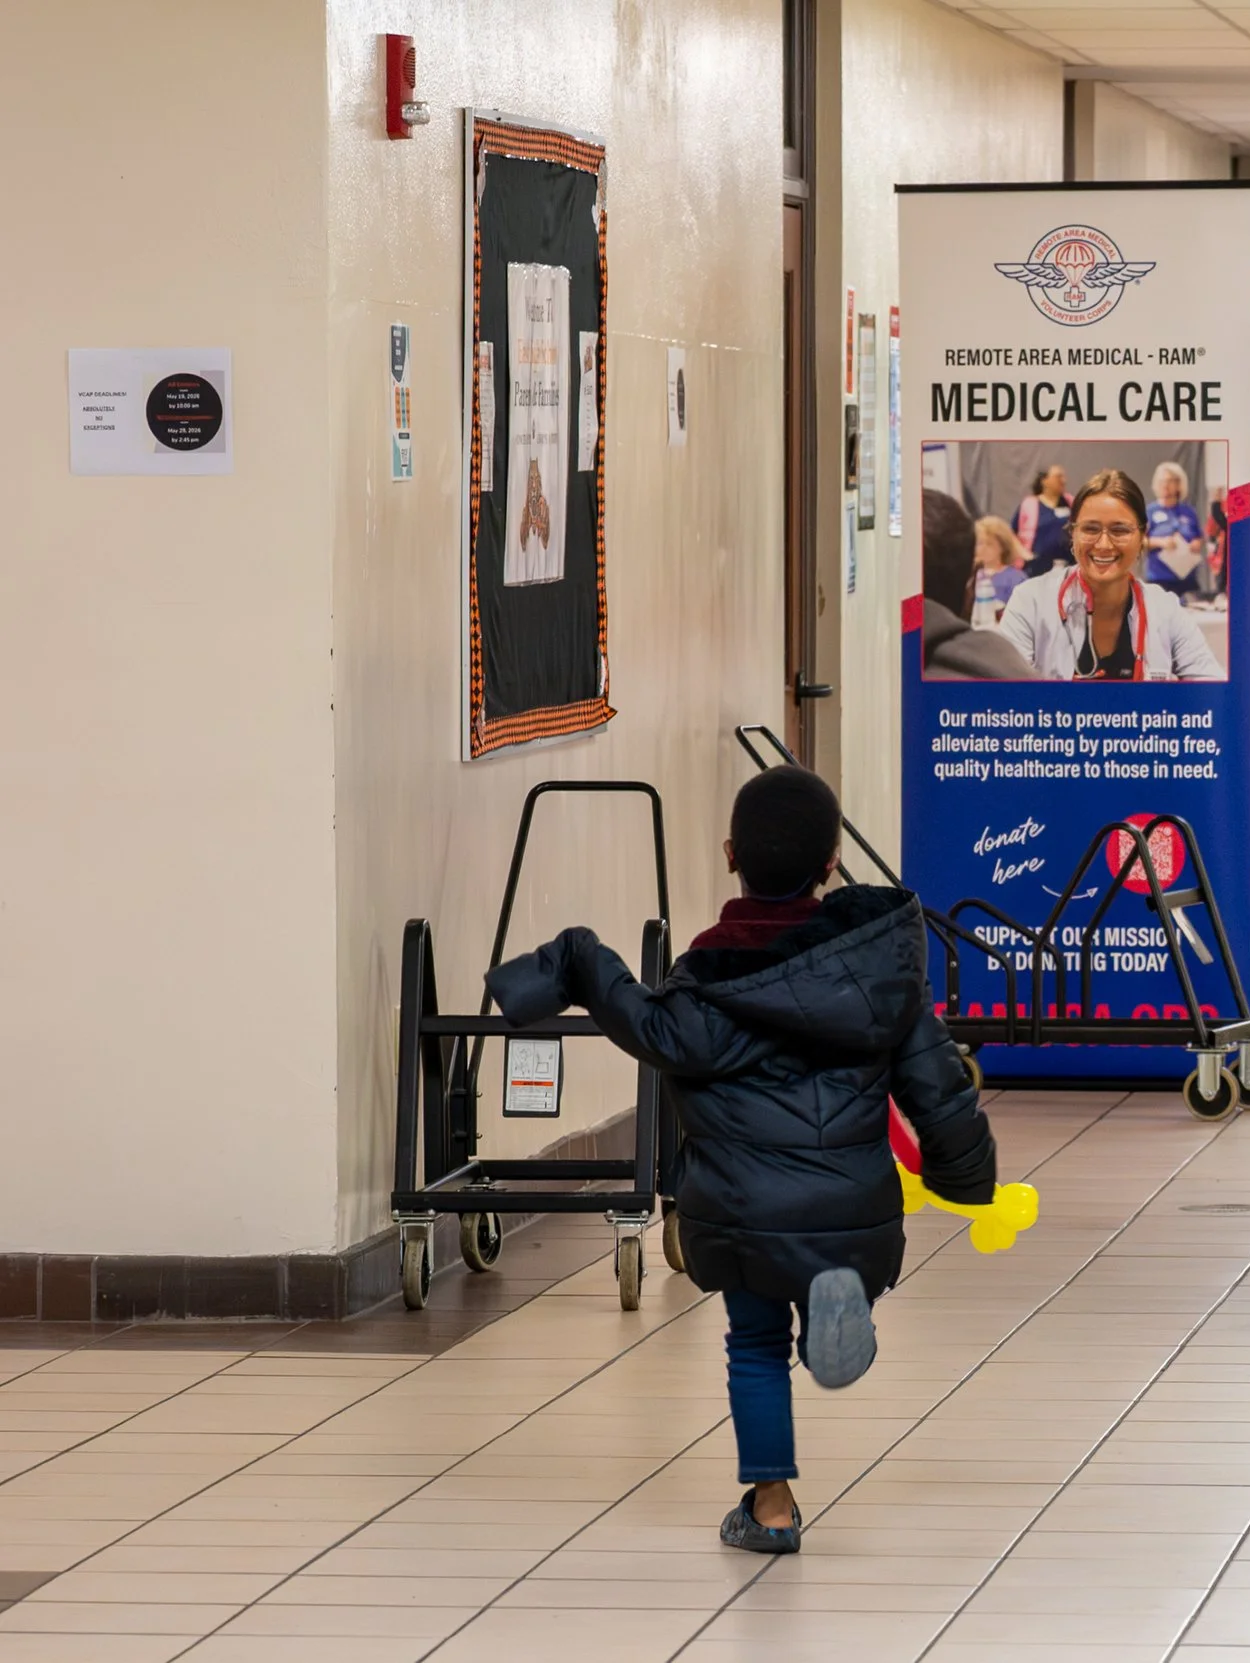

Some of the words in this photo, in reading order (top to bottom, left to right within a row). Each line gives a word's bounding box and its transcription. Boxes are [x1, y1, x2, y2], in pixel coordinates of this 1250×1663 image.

[1035, 233, 1062, 260] REMOTE
[1064, 229, 1086, 238] AREA
[1088, 232, 1117, 260] MEDICAL
[1040, 300, 1086, 322] VOLUNTEER
[1087, 300, 1112, 320] CORPS
[945, 348, 1013, 366] REMOTE
[1018, 348, 1062, 366] AREA
[1068, 348, 1143, 366] MEDICAL
[931, 382, 1108, 422] MEDICAL
[1118, 381, 1222, 422] CARE
[939, 710, 967, 728] Our
[971, 709, 1034, 728] mission
[1038, 710, 1052, 728] is
[1056, 711, 1072, 728] to
[1075, 712, 1137, 732] prevent
[1142, 710, 1177, 732] pain
[1181, 710, 1212, 728] and
[932, 734, 1000, 752] alleviate
[1003, 734, 1075, 757] suffering
[1080, 734, 1099, 757] by
[1103, 735, 1180, 758] providing
[1183, 736, 1221, 756] free,
[934, 759, 990, 781] quality
[994, 760, 1081, 778] healthcare
[1084, 762, 1100, 778] to
[1104, 760, 1148, 778] those
[1152, 760, 1168, 778] in
[1172, 760, 1218, 779] need.
[974, 816, 1046, 856] donate
[992, 857, 1045, 884] here
[987, 951, 1011, 970] B
[1110, 952, 1169, 972] TODAY
